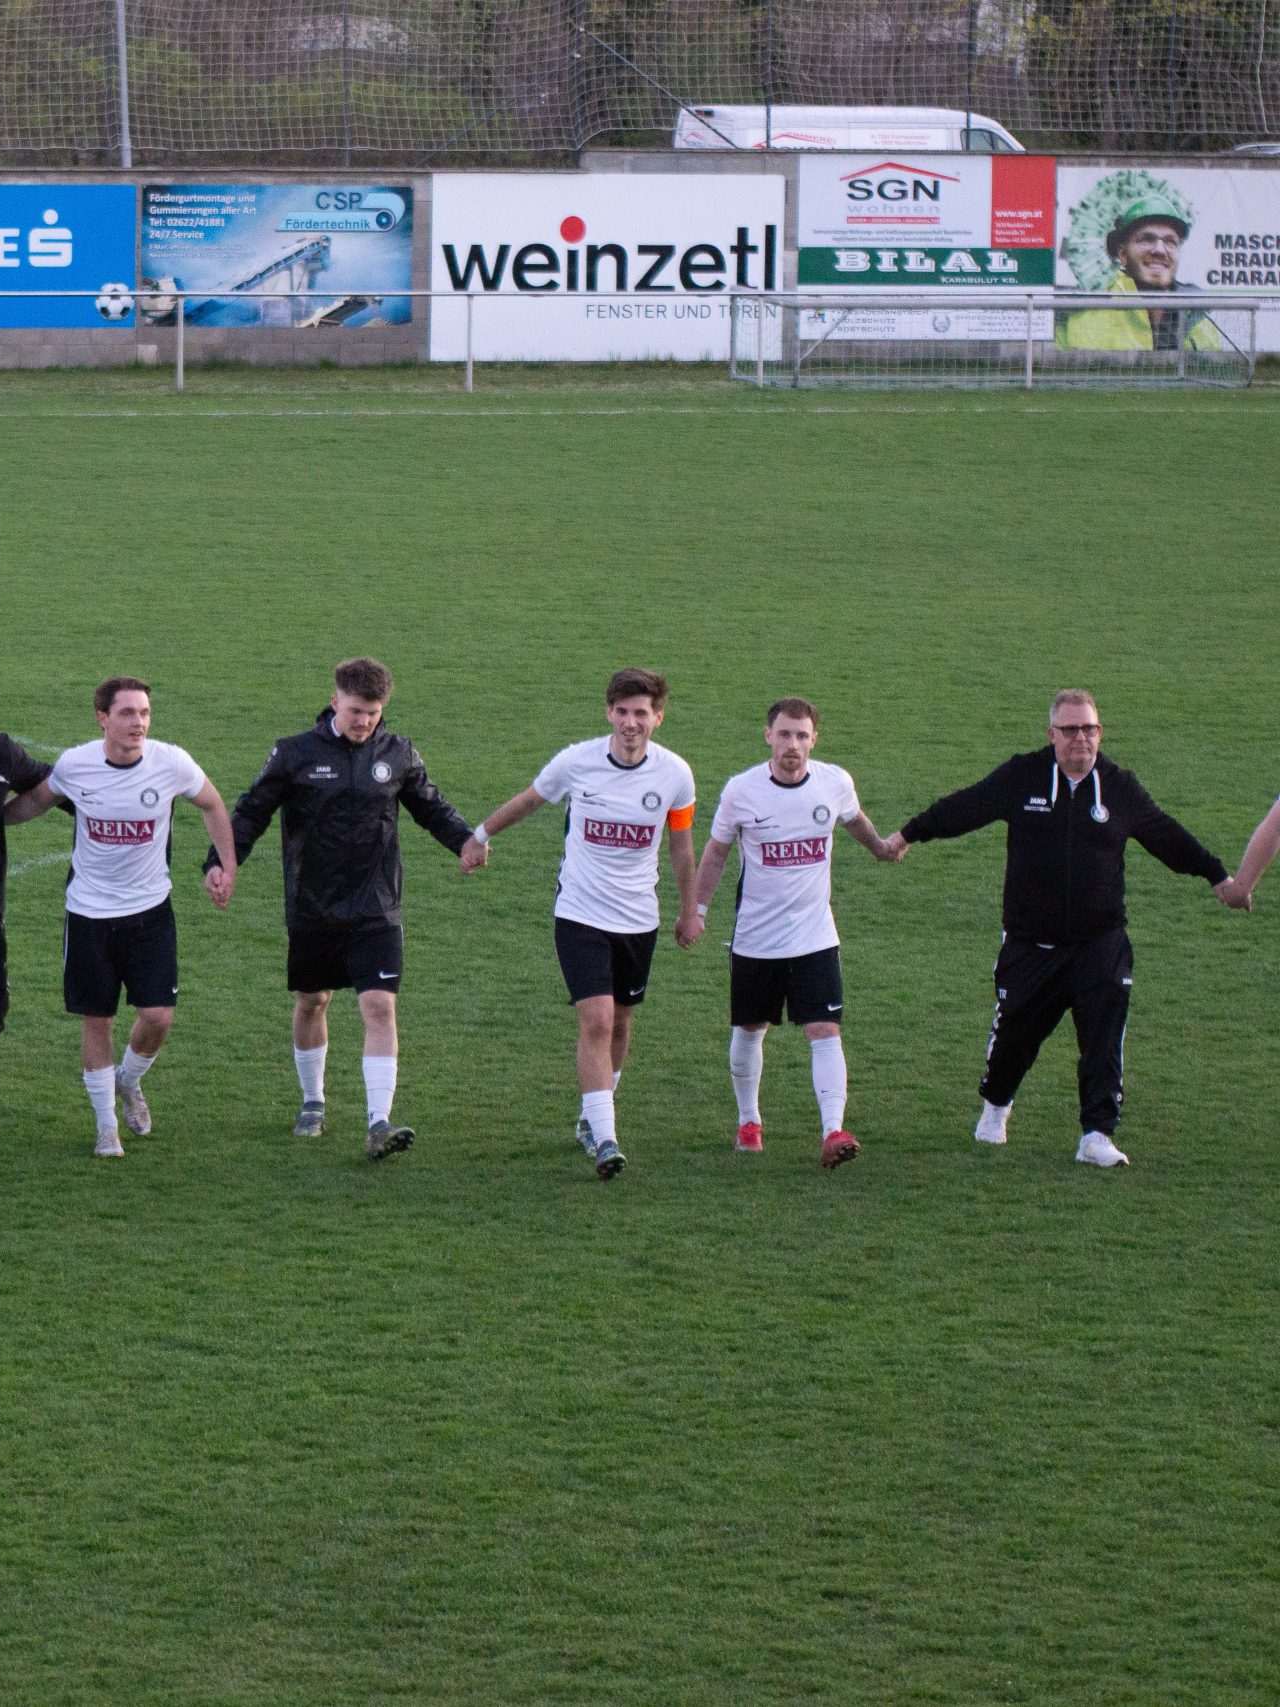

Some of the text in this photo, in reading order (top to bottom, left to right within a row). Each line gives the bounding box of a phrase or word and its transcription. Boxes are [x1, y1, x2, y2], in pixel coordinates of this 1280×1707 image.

[846, 179, 940, 201] SGN
[149, 193, 256, 204] Fördergurtmontage und
[315, 191, 363, 210] CSP
[149, 206, 257, 217] Gummierungen aller Art
[847, 204, 940, 214] wohnen
[149, 219, 165, 227] Tel:
[285, 219, 371, 230] Fördertechnik
[149, 231, 205, 240] 24/7 Service
[442, 216, 777, 297] weinzetl
[834, 251, 1018, 273] BILAL
[1206, 269, 1280, 286] CHARA
[585, 304, 667, 319] FENSTER
[674, 304, 711, 319] UND
[1030, 797, 1046, 805] JAKO
[89, 820, 151, 837] REINA
[586, 821, 651, 841] REINA
[764, 840, 824, 858] REINA
